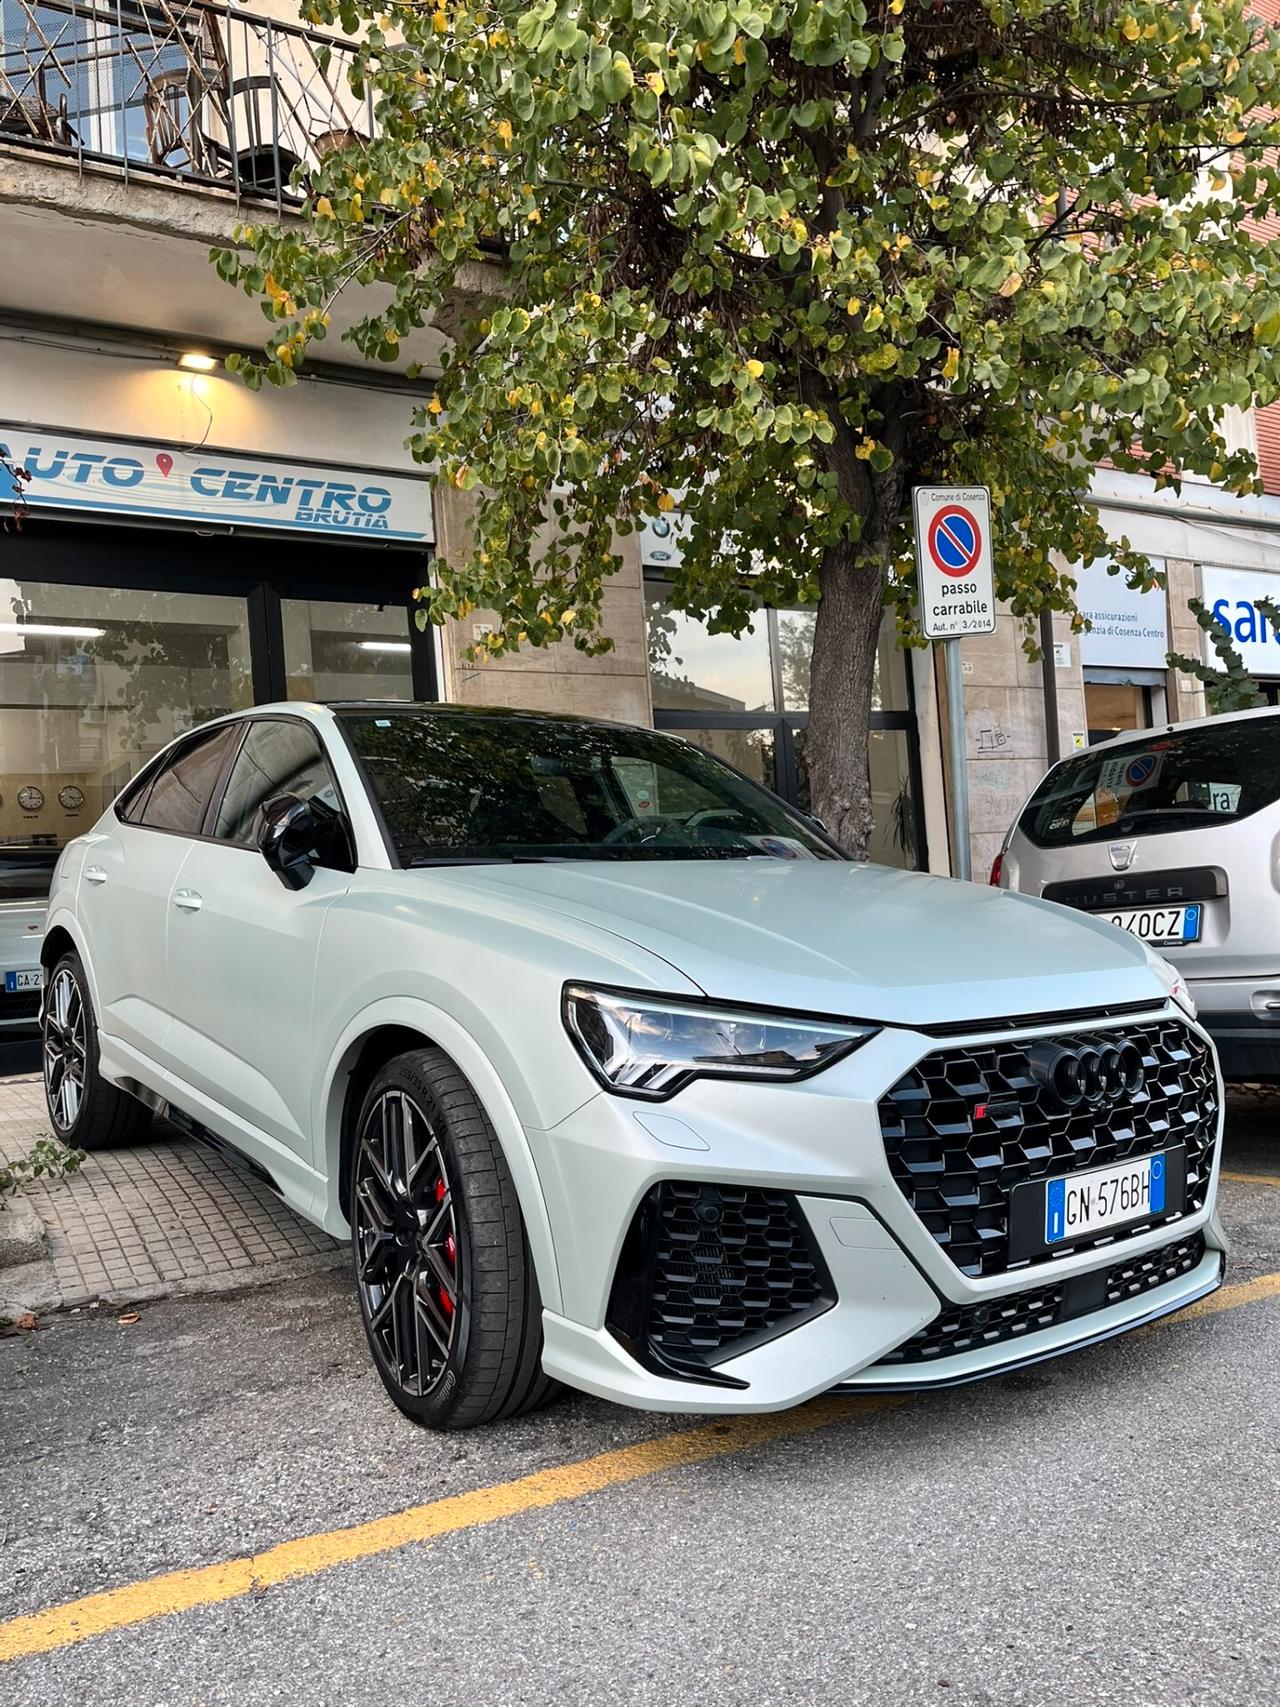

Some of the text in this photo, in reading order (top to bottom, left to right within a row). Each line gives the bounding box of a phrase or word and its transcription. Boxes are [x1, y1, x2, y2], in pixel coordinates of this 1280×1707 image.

[190, 468, 392, 514] CENTRO
[931, 492, 986, 501] Comune di Cosenza
[295, 507, 389, 529] BRUTIA
[941, 583, 977, 597] passo
[932, 600, 988, 616] carrabile
[1094, 611, 1138, 622] assicurazioni
[933, 623, 948, 631] Aut.
[962, 619, 991, 629] 3/2014
[1107, 626, 1114, 635] di
[1114, 626, 1141, 637] Cosenza
[1142, 628, 1165, 638] Centro
[1098, 1169, 1151, 1217] 576BH
